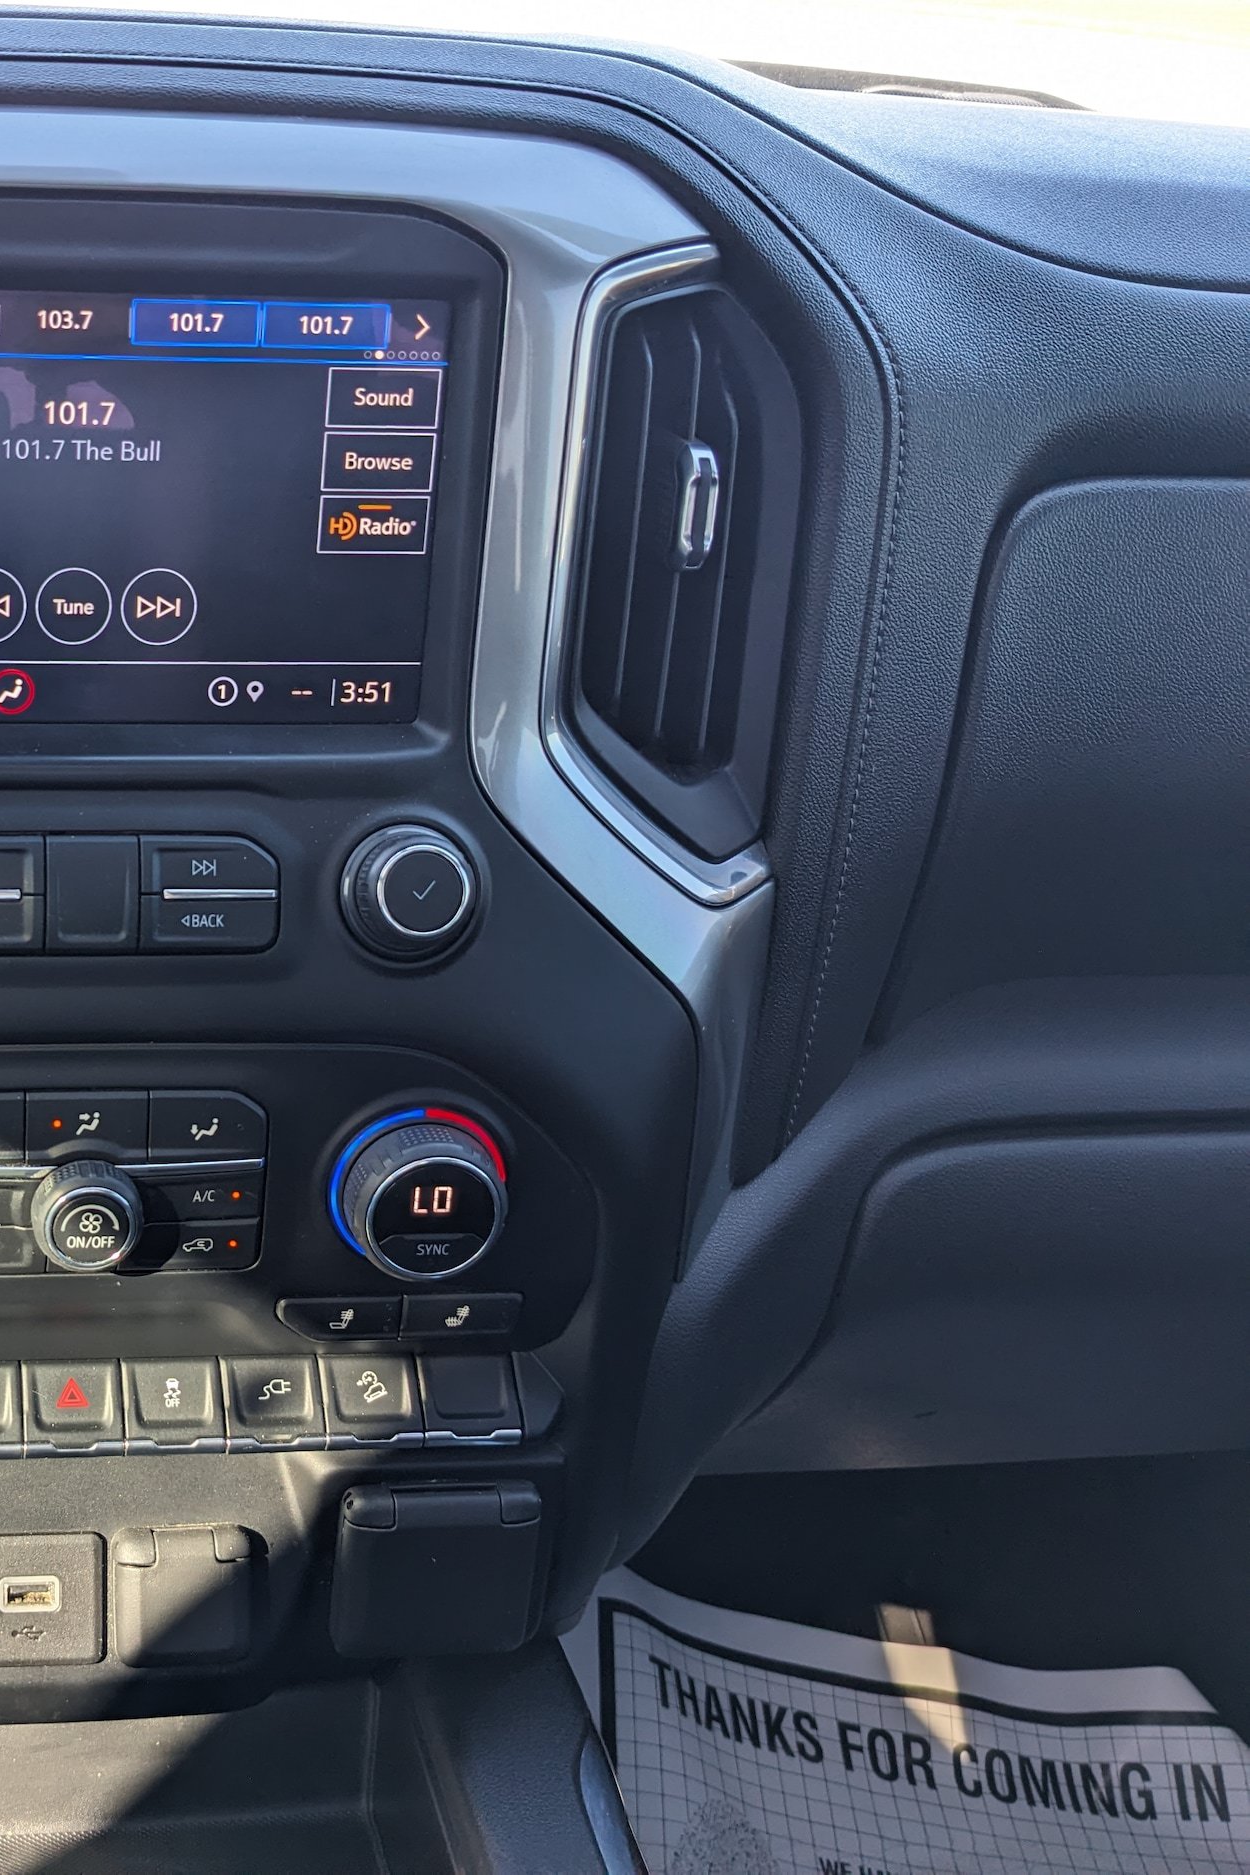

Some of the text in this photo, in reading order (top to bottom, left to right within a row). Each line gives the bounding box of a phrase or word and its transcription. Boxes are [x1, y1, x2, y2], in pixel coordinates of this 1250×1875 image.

[37, 310, 93, 330] 103.7
[169, 312, 225, 333] 101.7
[299, 316, 354, 336] 101.7
[353, 387, 414, 407] Sound
[44, 401, 116, 426] 101.7
[2, 438, 161, 462] 101.7 The Bull
[344, 451, 414, 471] Browse
[52, 599, 95, 616] Tune
[340, 681, 392, 703] 3:51
[191, 914, 225, 928] BACK
[193, 1189, 216, 1203] A/C
[413, 1186, 454, 1215] LO
[66, 1235, 116, 1249] ON/OFF
[416, 1243, 450, 1256] SYNC
[165, 1398, 181, 1408] OFF
[648, 1654, 1232, 1823] THANKS FOR COMING IN
